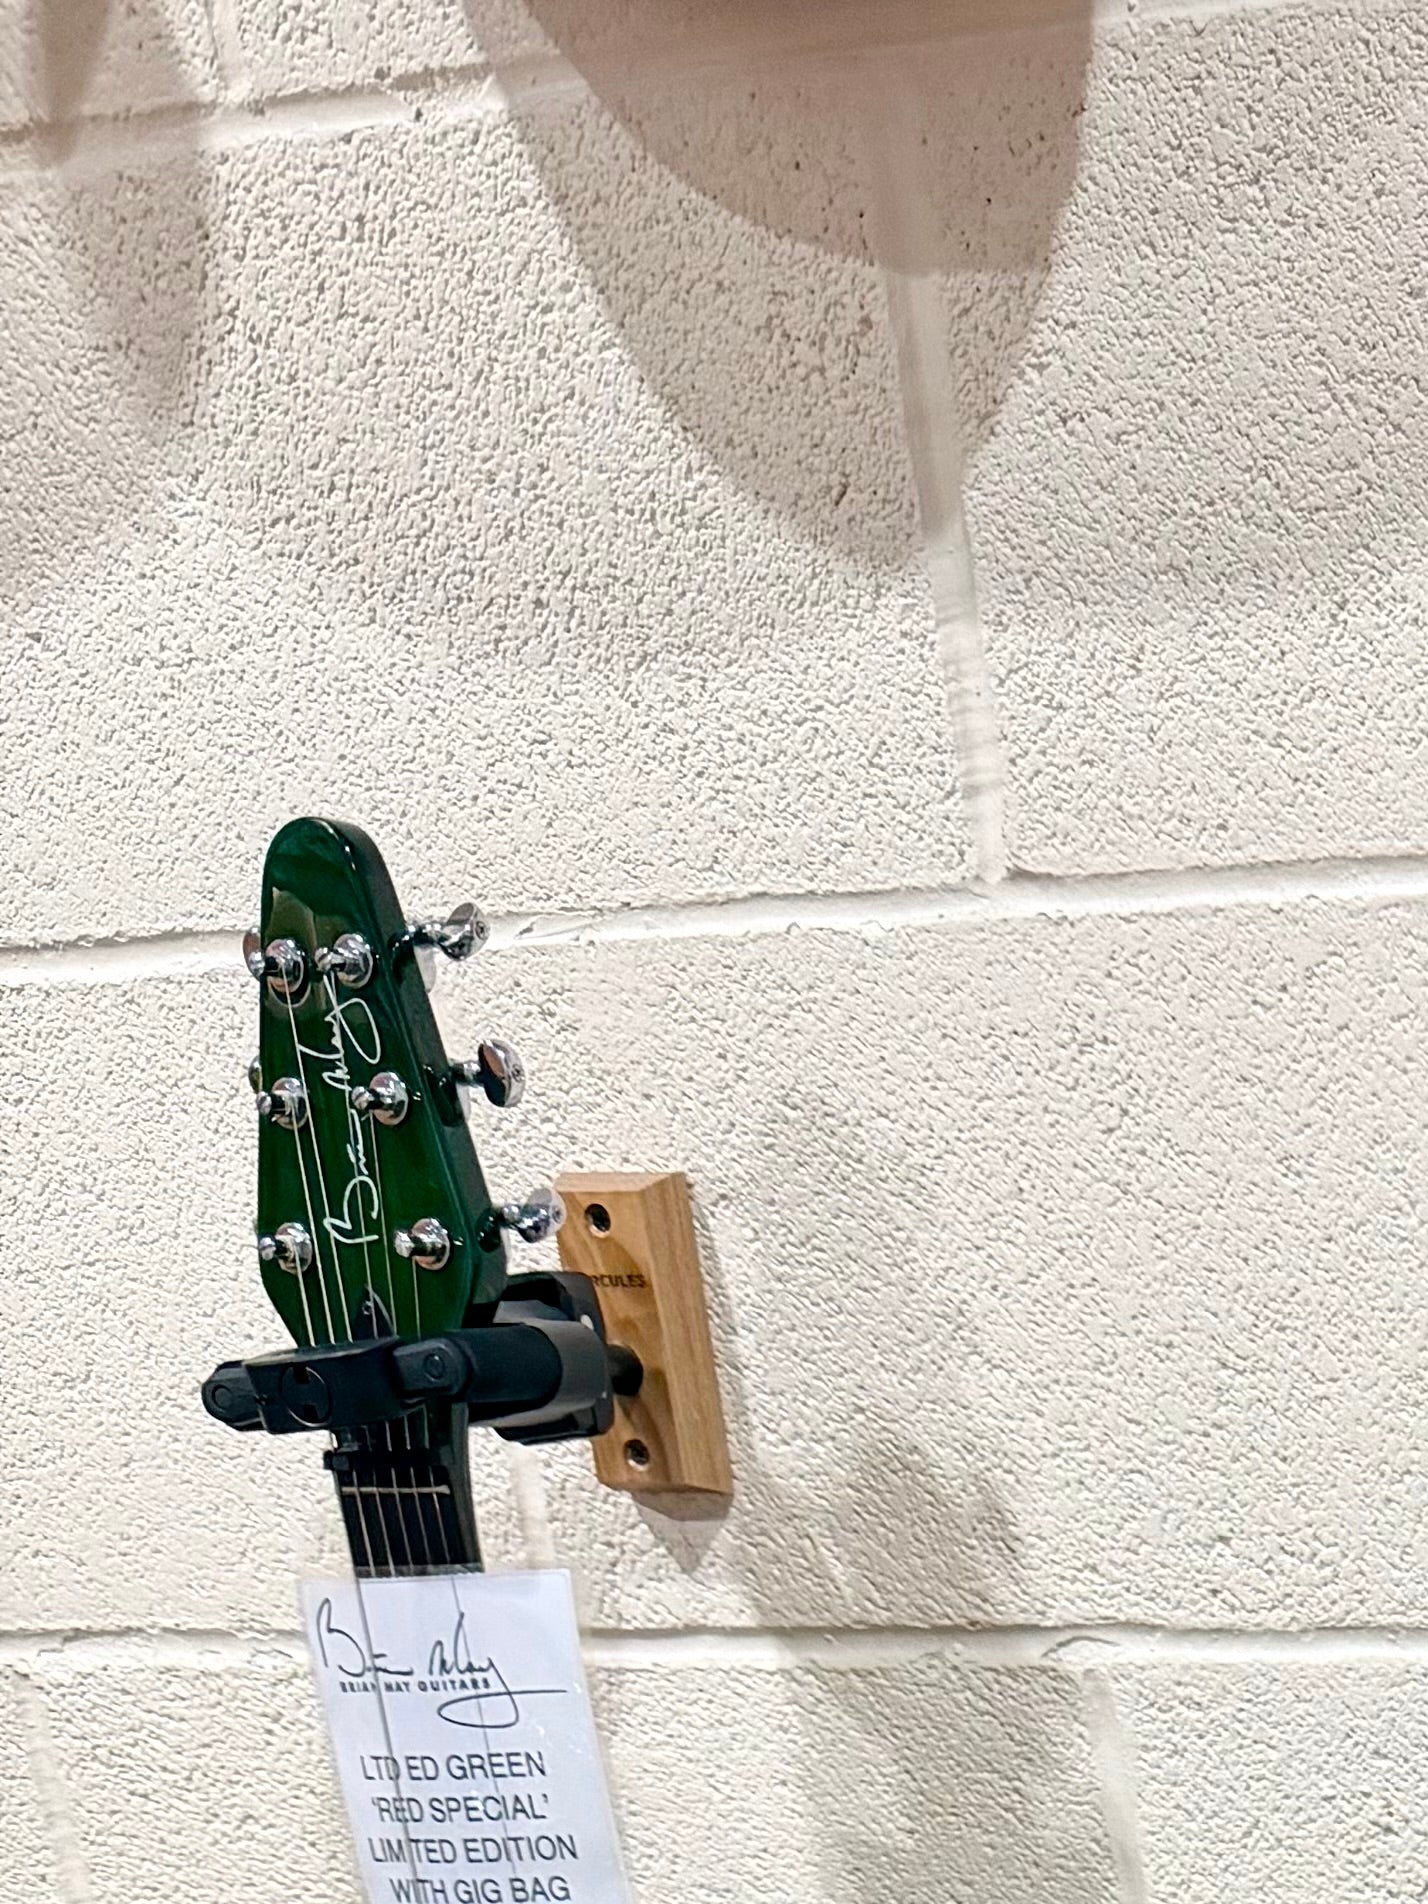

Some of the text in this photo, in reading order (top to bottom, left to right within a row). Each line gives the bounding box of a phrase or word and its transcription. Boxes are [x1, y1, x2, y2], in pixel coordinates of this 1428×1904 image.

[591, 1273, 646, 1289] RCULES
[418, 1677, 490, 1692] GUITARS
[360, 1751, 547, 1781] LTD ED GREEN
[368, 1834, 579, 1864] LIMTED EDITION
[389, 1876, 571, 1904] WITH GIG BAG
